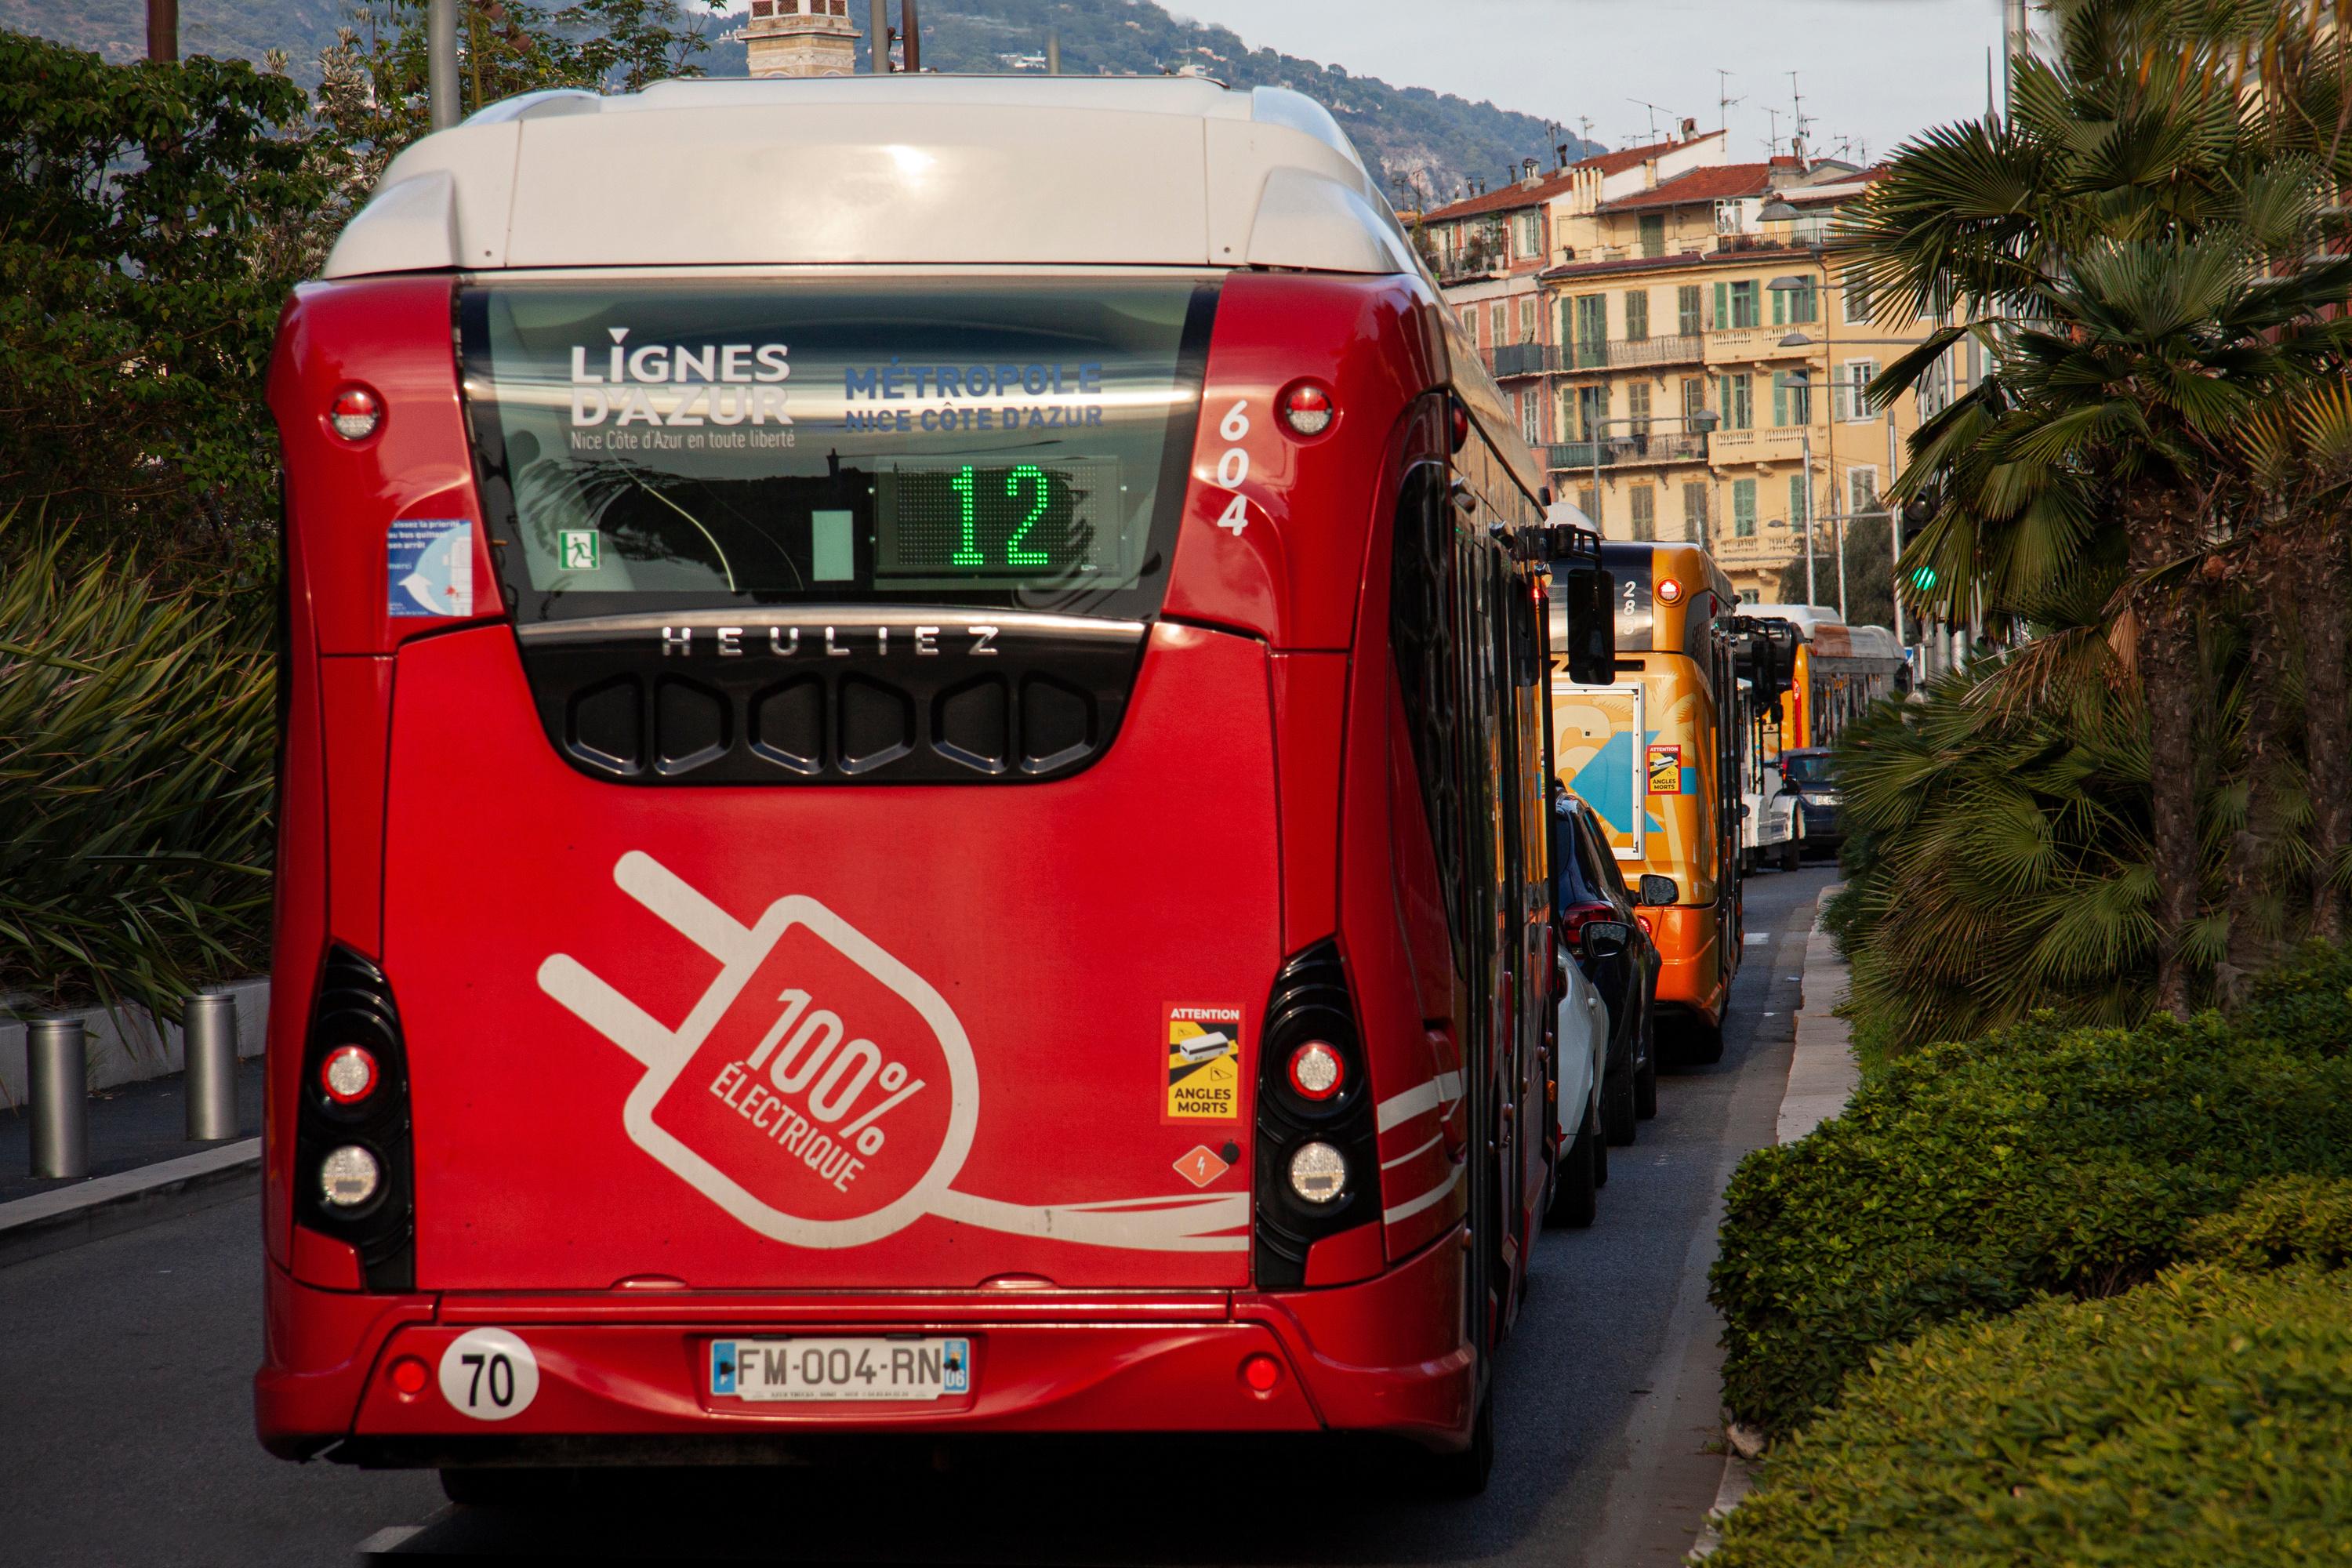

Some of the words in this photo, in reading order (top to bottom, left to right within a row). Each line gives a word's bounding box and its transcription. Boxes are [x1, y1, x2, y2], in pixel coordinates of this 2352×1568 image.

[845, 356, 1102, 400] MÉTROPOLE
[571, 386, 794, 426] D'AZUR
[846, 408, 913, 432] NICE
[920, 401, 993, 431] CÔTE
[1002, 405, 1103, 430] D'AZUR
[571, 431, 602, 450] Nice
[606, 429, 638, 450] Côte
[642, 429, 684, 449] d'Azur
[688, 434, 704, 448] en
[709, 432, 746, 448] toute
[750, 429, 795, 448] liberté
[1217, 399, 1250, 537] 604
[952, 465, 1048, 565] 12
[662, 626, 999, 656] HEULIEZ
[1171, 1007, 1240, 1020] ATTENTION
[746, 988, 927, 1156] 100%
[1174, 1087, 1232, 1099] ANGLES
[1178, 1102, 1228, 1113] MORTS
[709, 1060, 866, 1193] ÉLECTRIQUE
[461, 1353, 515, 1407] 70
[738, 1348, 941, 1385] FM-004-RN
